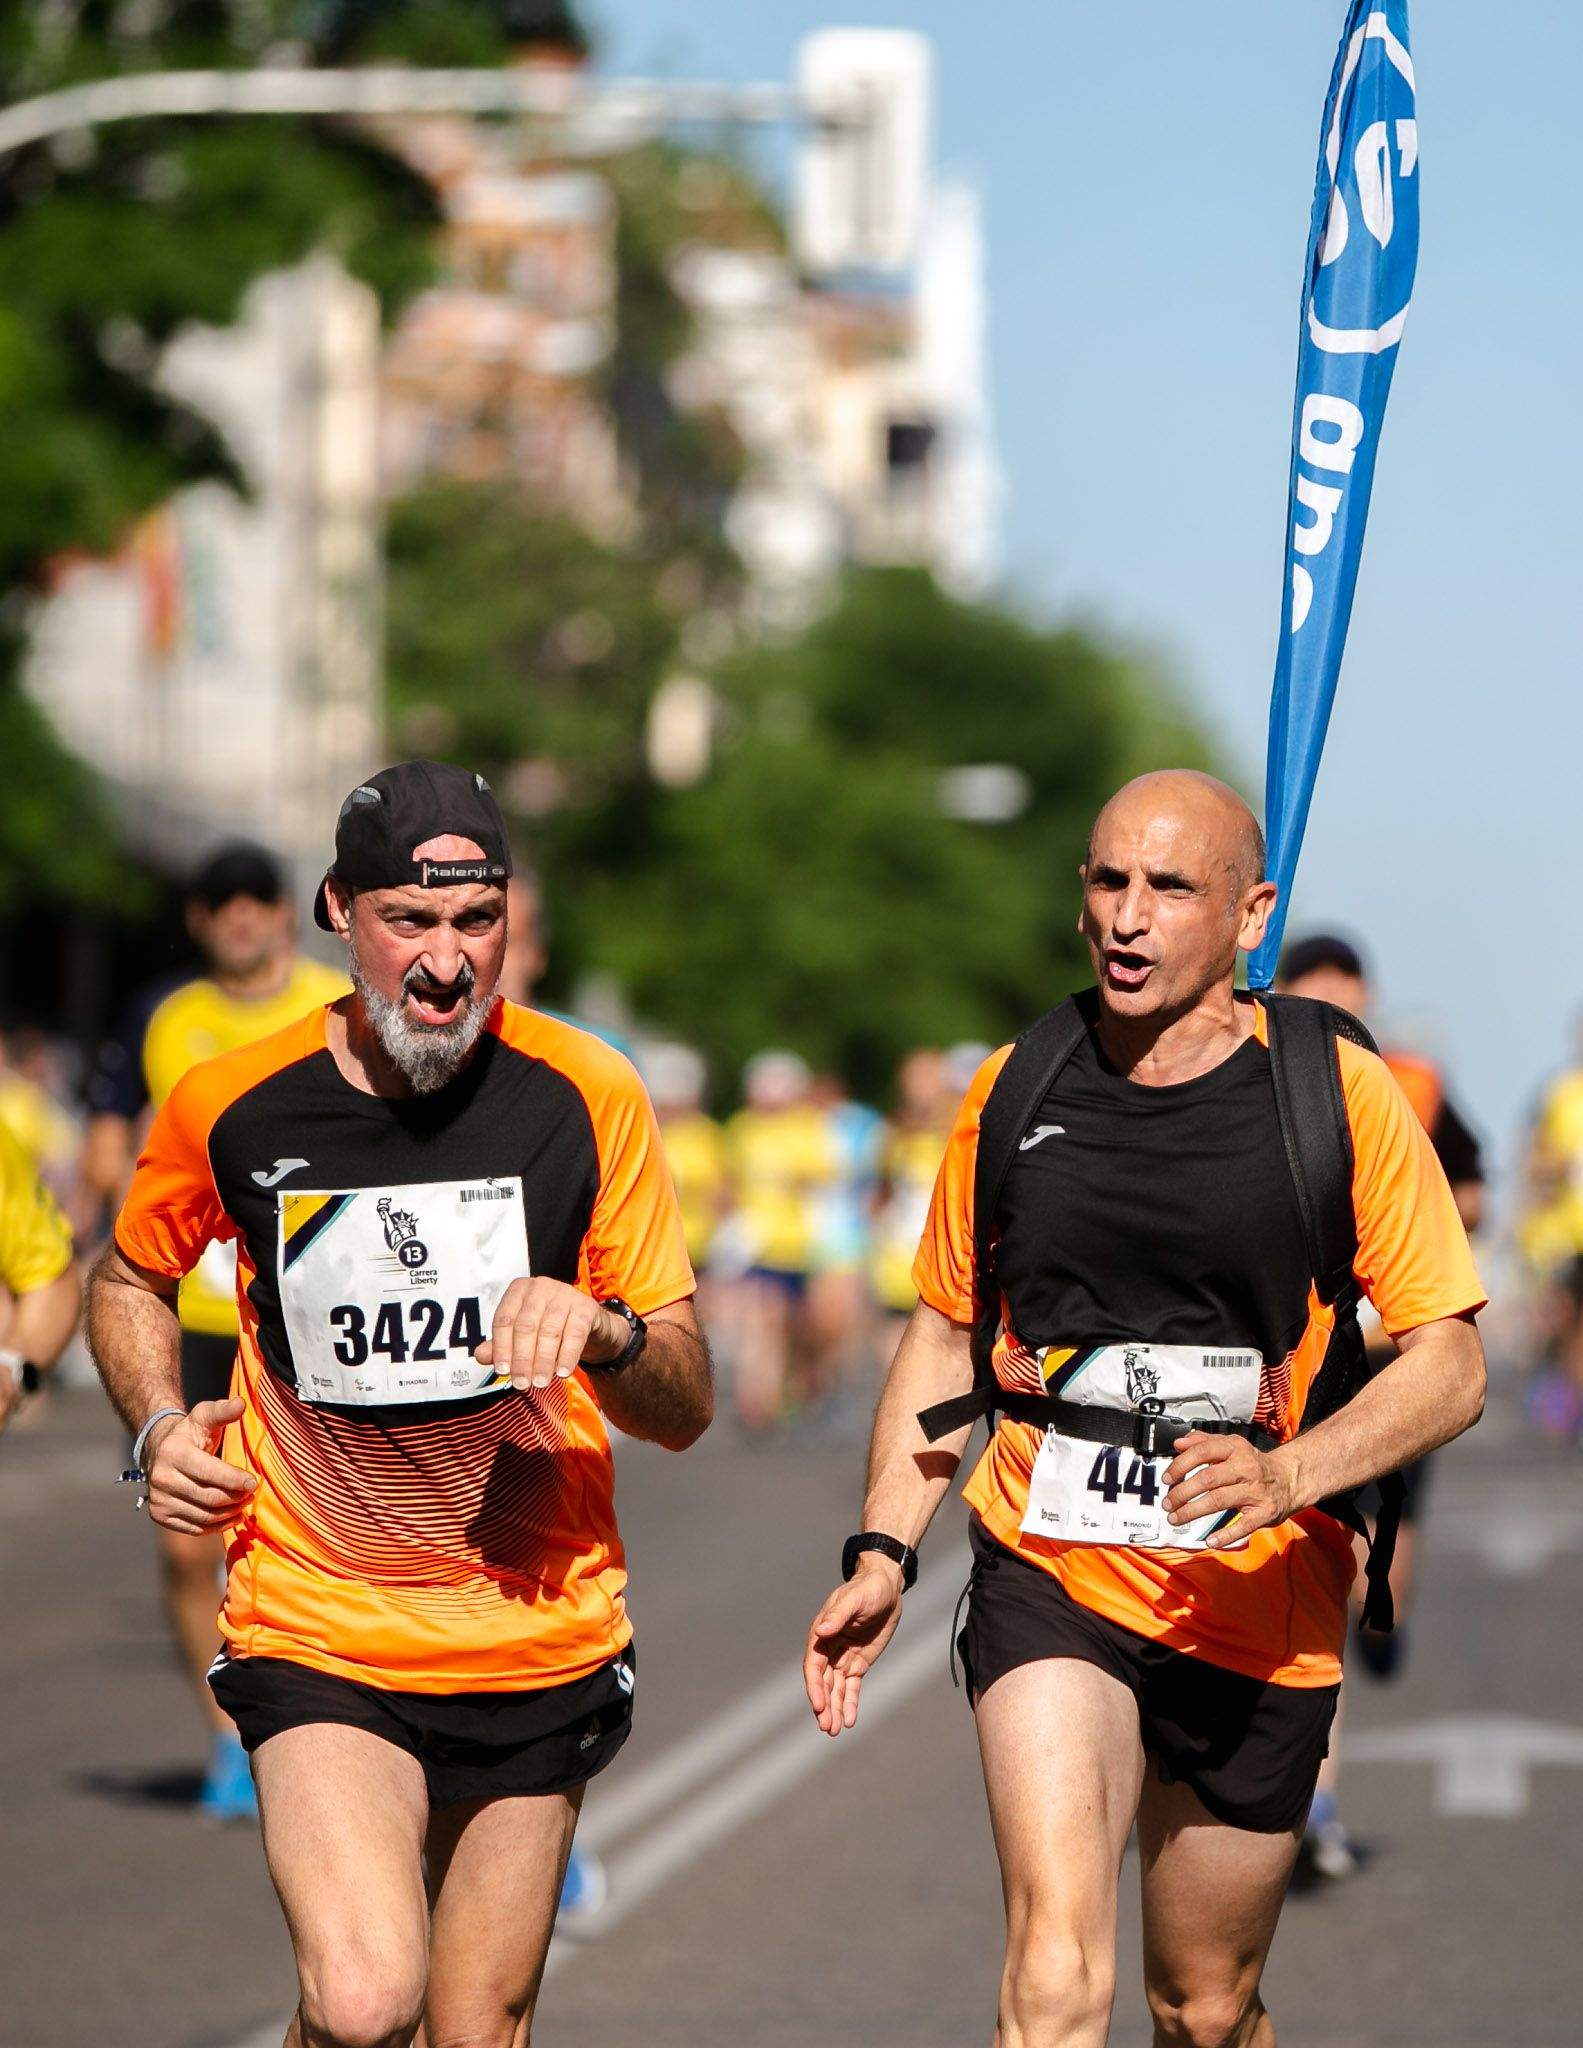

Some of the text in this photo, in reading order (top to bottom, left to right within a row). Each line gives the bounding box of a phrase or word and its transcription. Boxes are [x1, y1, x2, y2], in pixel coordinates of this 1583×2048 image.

[403, 1246, 423, 1263] 13
[409, 1269, 438, 1278] Carrera
[410, 1277, 438, 1286] Liberty
[330, 1296, 487, 1367] 3424
[1087, 1445, 1170, 1507] 44
